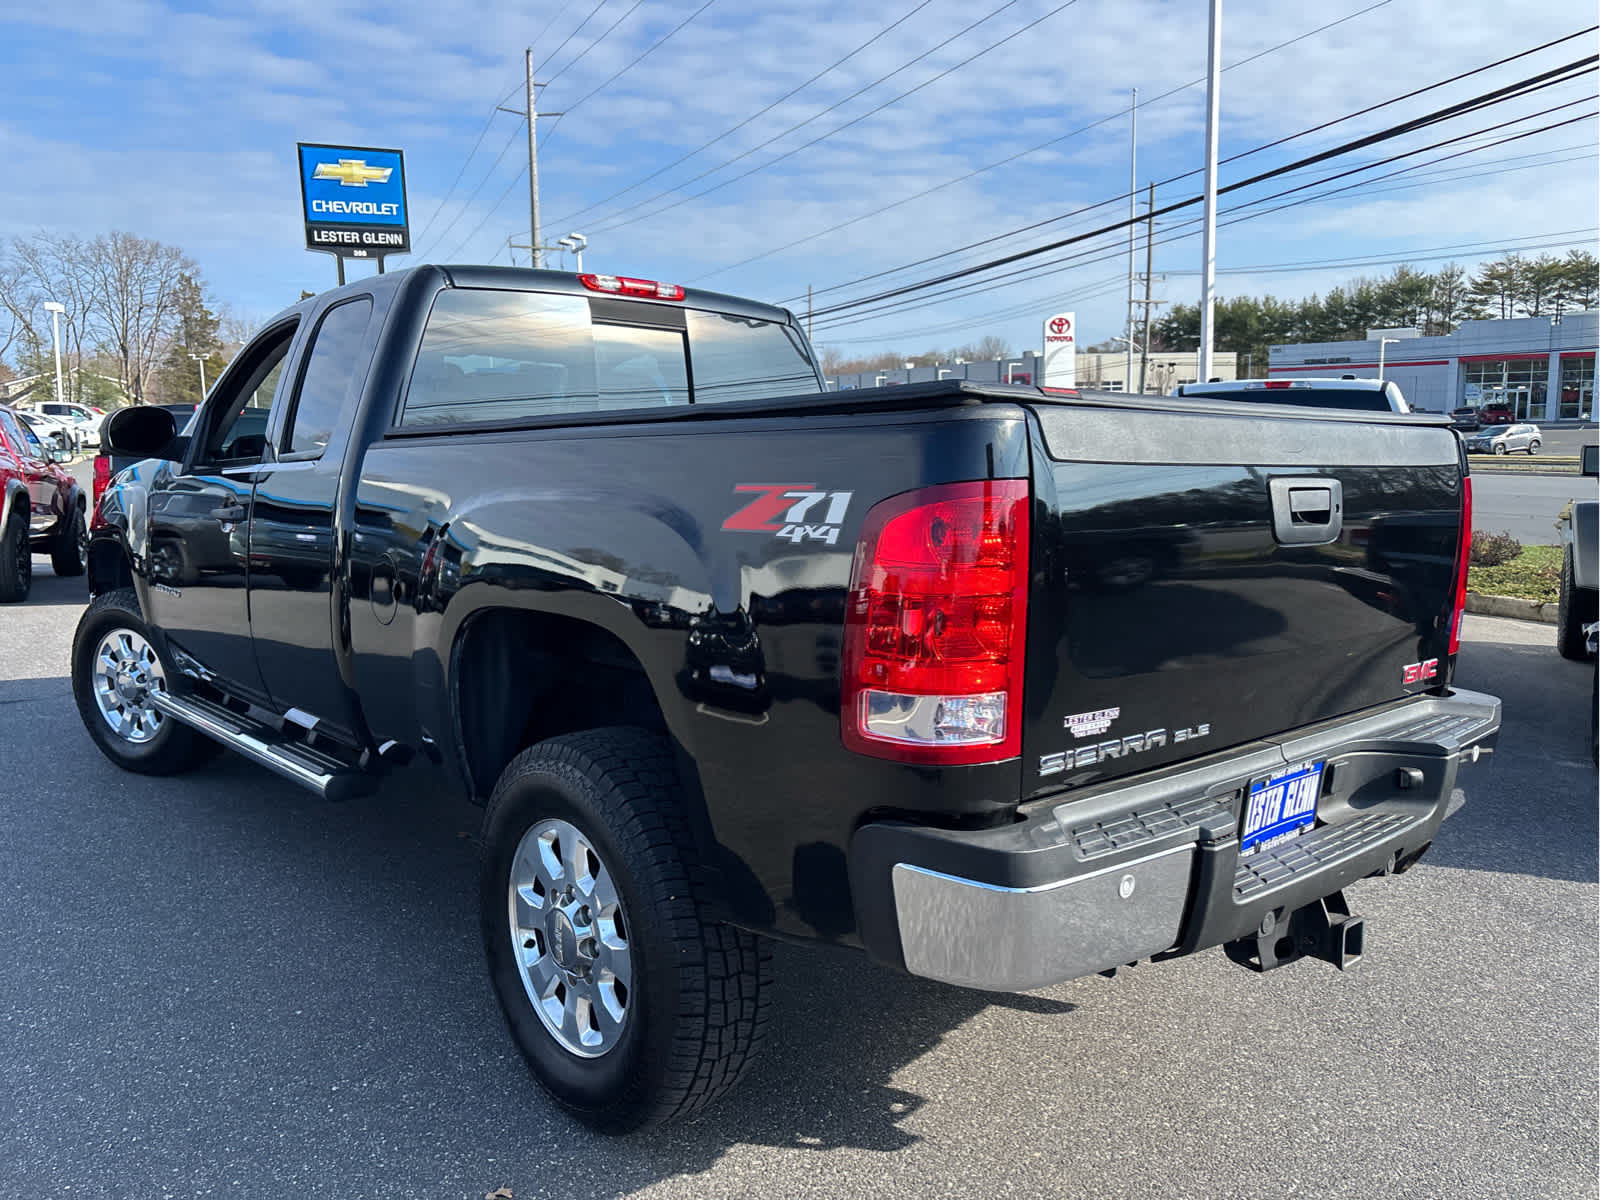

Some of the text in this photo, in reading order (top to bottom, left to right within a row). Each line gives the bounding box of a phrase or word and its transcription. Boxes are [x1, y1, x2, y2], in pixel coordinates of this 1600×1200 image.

[312, 199, 400, 216] CHEVROLET
[313, 230, 404, 246] LESTER GLENN
[1046, 335, 1074, 343] TOYOTA
[720, 483, 853, 532] Z71
[1402, 657, 1438, 685] GMC
[1038, 723, 1211, 777] SIERRA SLE
[1243, 773, 1321, 837] LESTER GLENN
